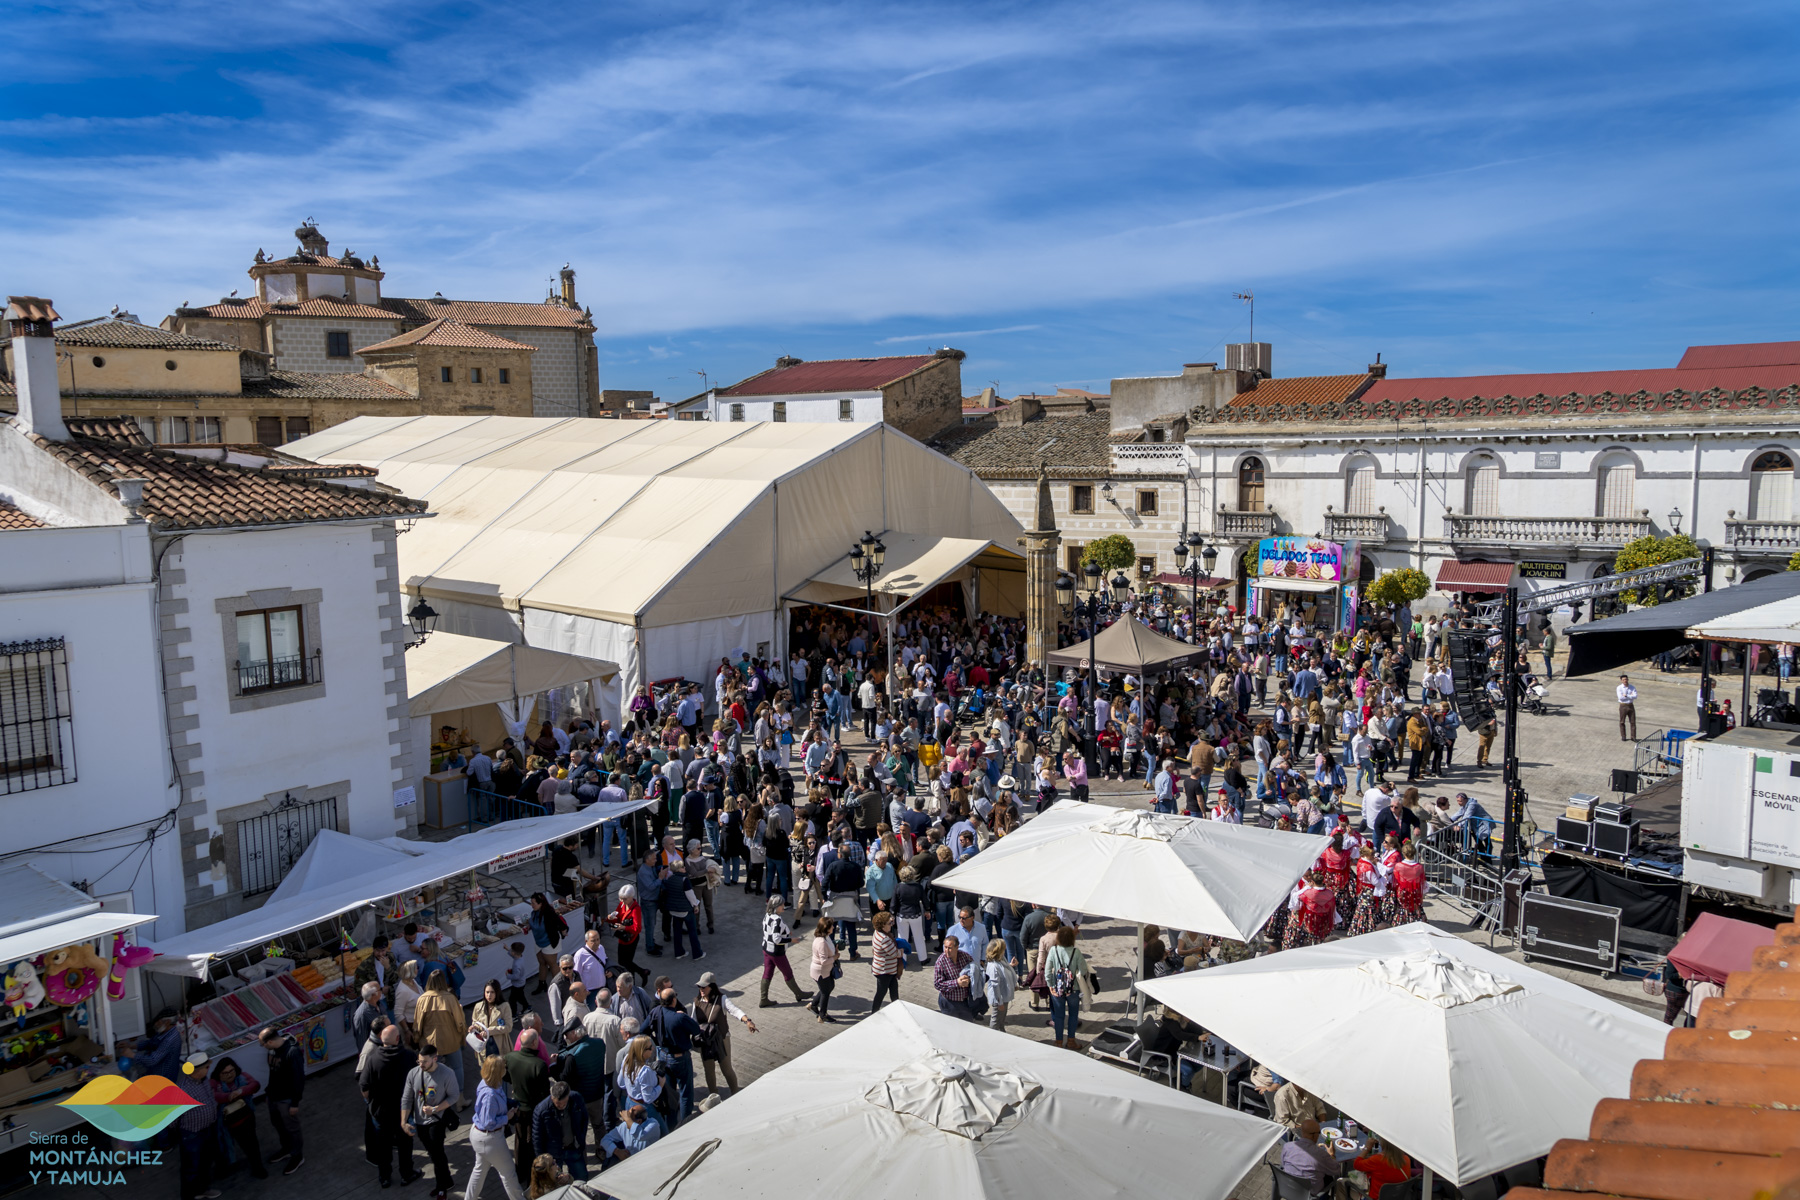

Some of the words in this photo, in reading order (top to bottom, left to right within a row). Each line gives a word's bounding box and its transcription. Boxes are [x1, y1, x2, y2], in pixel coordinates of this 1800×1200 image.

[1262, 549, 1307, 562] HELADOS
[1310, 553, 1337, 565] TENA
[1764, 800, 1795, 811] MÓVIL
